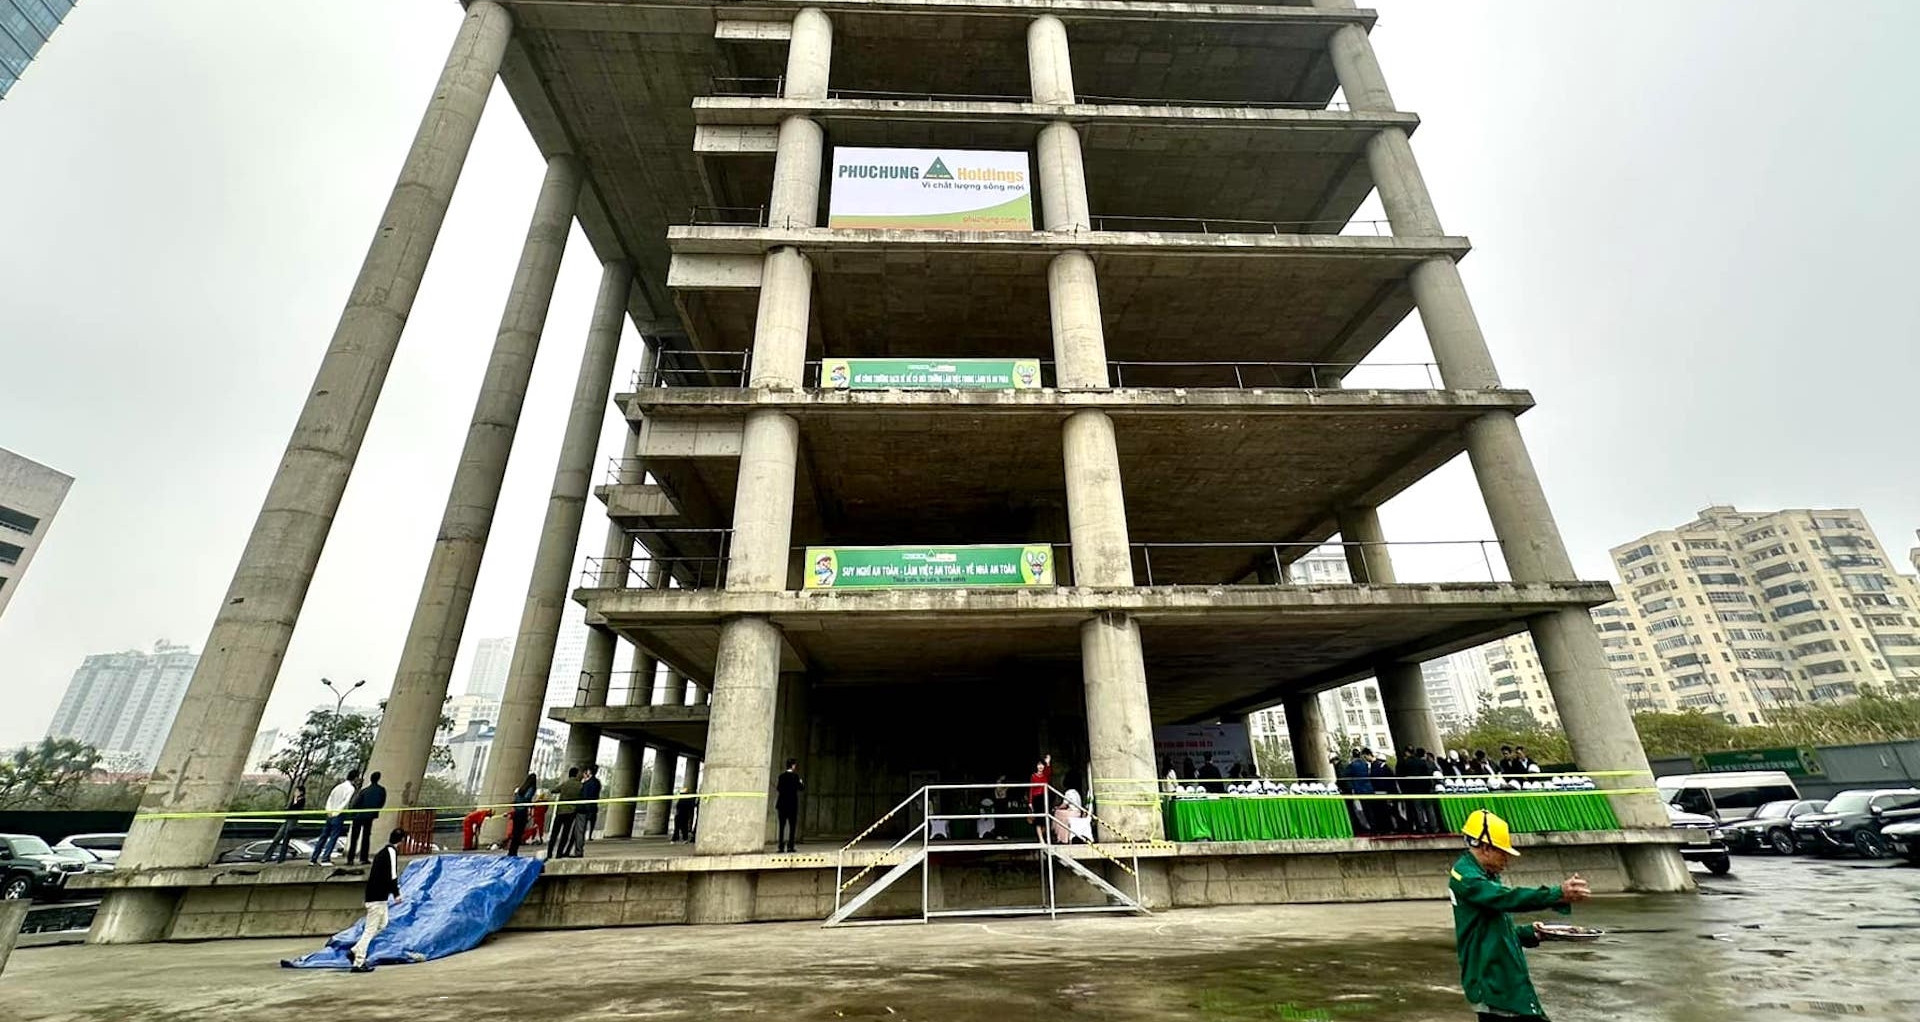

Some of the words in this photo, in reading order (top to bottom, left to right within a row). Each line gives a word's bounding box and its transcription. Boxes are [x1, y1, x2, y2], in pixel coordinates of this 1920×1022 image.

[838, 164, 919, 180] PHUCHUNG
[957, 167, 1024, 183] Holdings
[842, 566, 855, 576] SUY
[856, 564, 871, 576] NGHĨ
[872, 566, 881, 576] AN
[882, 563, 899, 576] TOÀN
[904, 564, 917, 576] LÀM
[919, 564, 933, 576] VIỆC
[934, 565, 943, 575] AN
[944, 563, 961, 575] TOÀN
[966, 562, 974, 574] VỀ
[976, 563, 988, 574] NHÀ
[990, 565, 999, 574] AN
[1000, 563, 1016, 574] TOÀN
